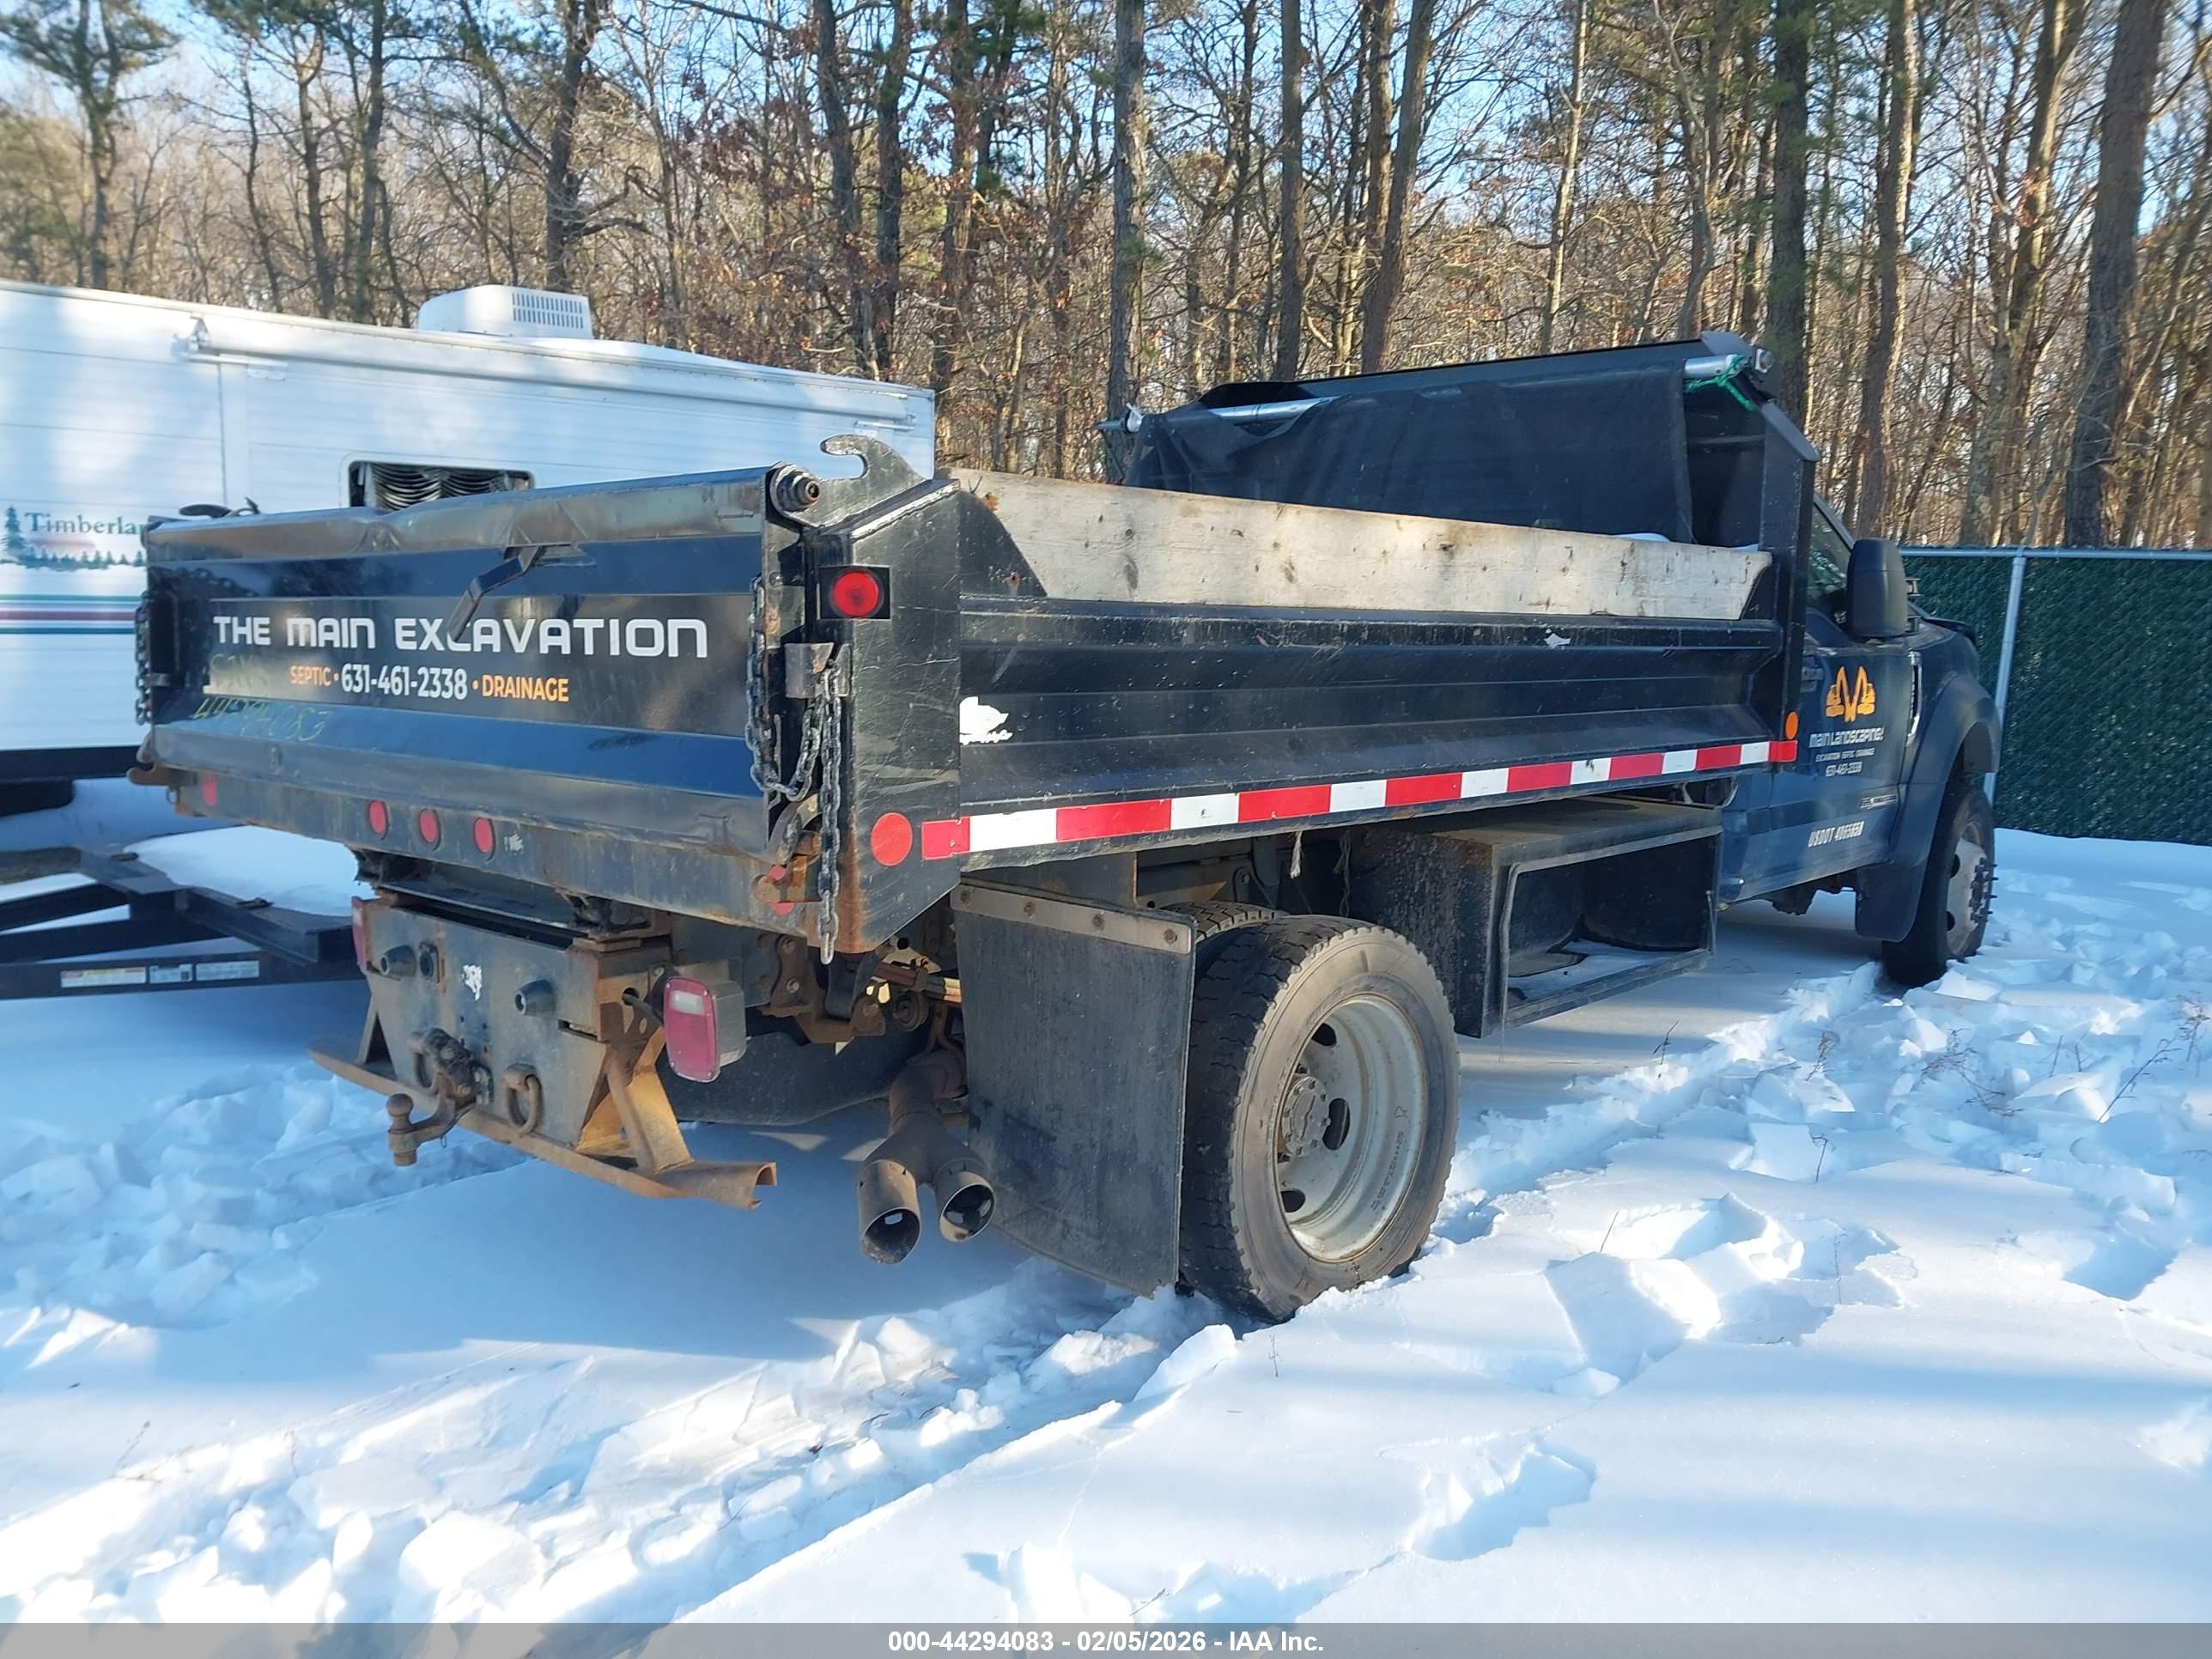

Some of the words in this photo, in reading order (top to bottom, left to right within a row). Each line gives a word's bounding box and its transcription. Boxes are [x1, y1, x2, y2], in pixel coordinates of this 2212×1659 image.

[213, 616, 270, 646] THE
[394, 618, 708, 659] EXCAVATION
[289, 665, 331, 687] SEPTIC
[341, 663, 467, 702] 631-461-2338
[482, 673, 569, 703] DRAINAGE
